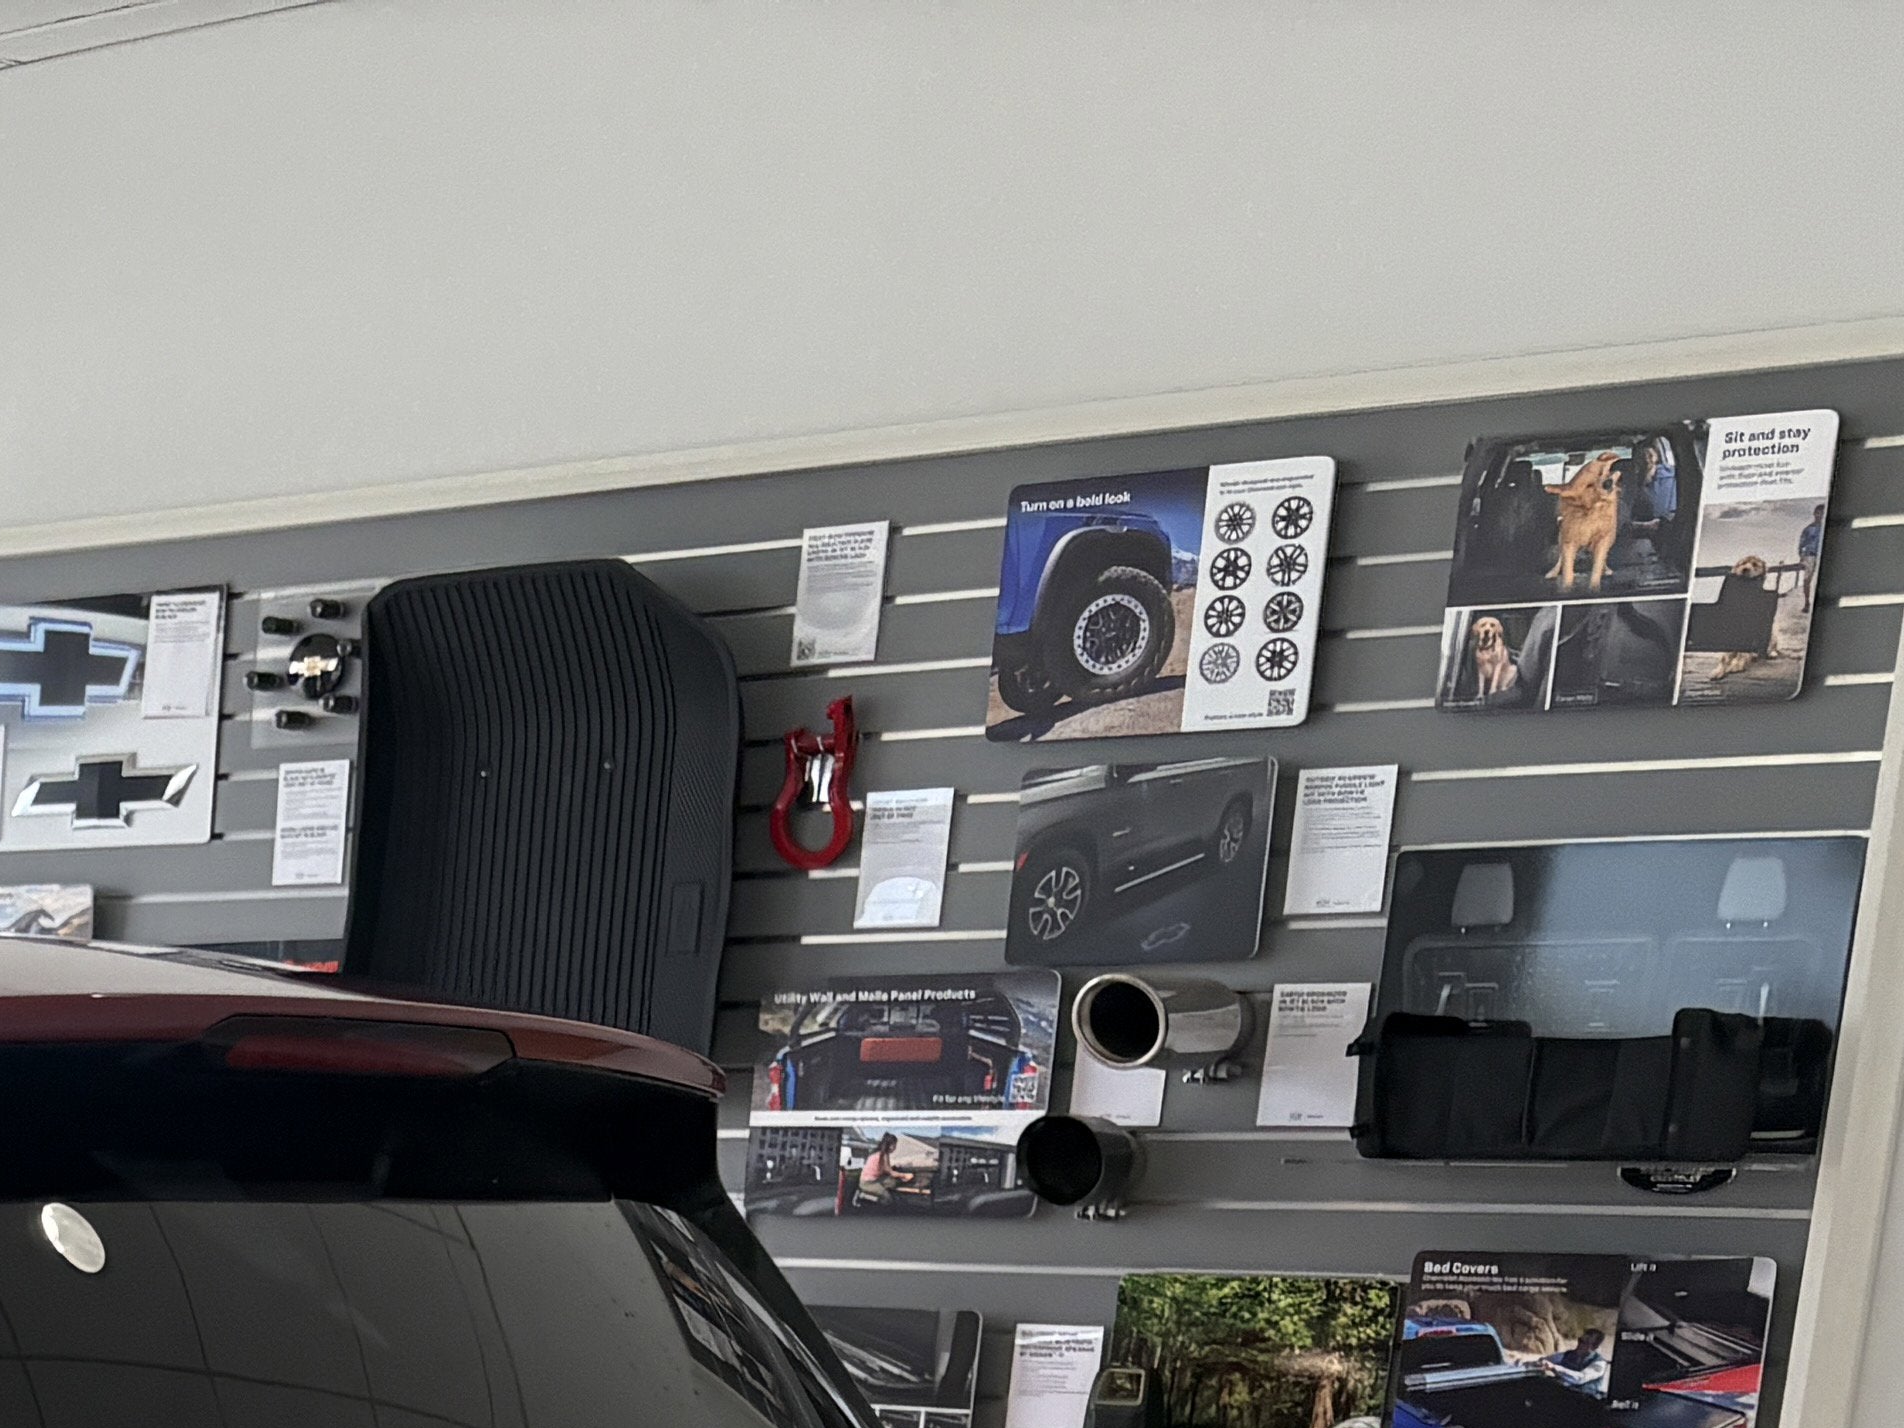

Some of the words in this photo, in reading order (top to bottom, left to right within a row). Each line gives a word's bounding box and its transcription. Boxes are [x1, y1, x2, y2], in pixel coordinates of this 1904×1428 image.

[1725, 431, 1745, 444] Sit
[1748, 428, 1775, 442] and
[1779, 428, 1811, 441] stay
[1722, 442, 1799, 460] protection
[1021, 501, 1047, 513] Turn
[1048, 500, 1064, 510] on
[1076, 493, 1103, 508] bold
[1104, 491, 1131, 505] look
[774, 993, 807, 1006] Utility
[809, 991, 834, 1003] Wall
[835, 990, 856, 1003] and
[890, 989, 922, 1001] Panel
[924, 989, 976, 1001] Products
[1424, 1261, 1450, 1274] Bed
[1452, 1262, 1499, 1275] Covers
[1631, 1262, 1648, 1272] Lift
